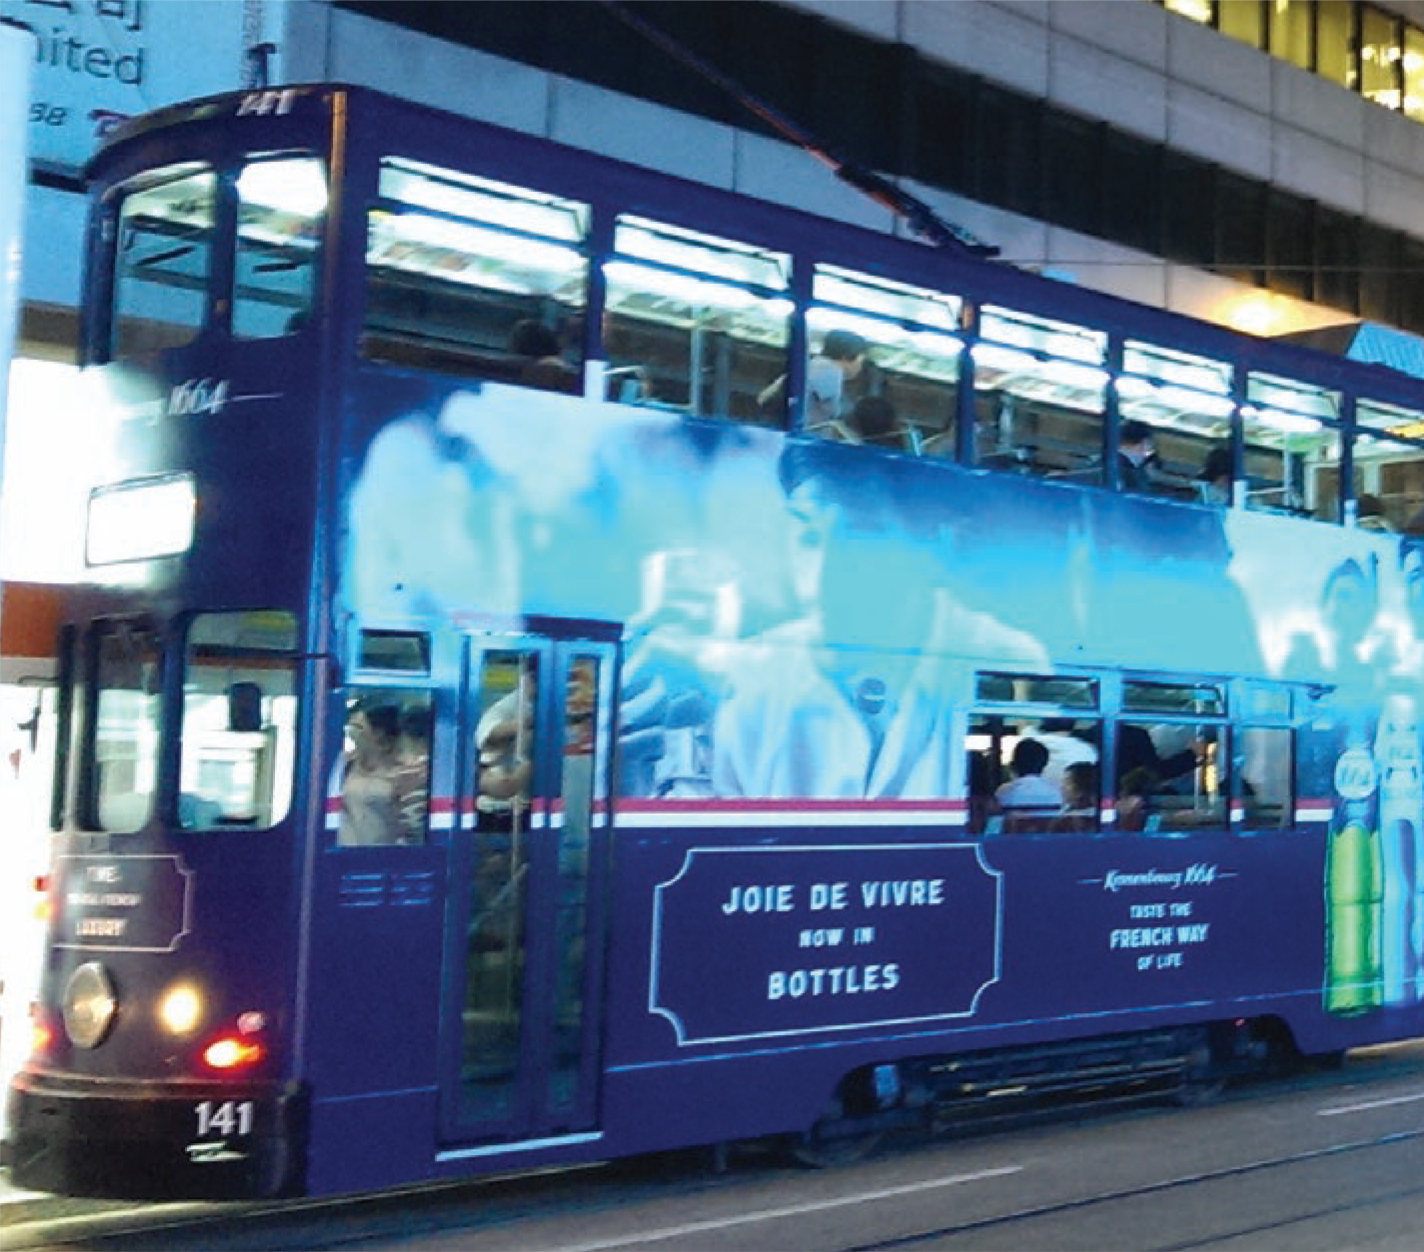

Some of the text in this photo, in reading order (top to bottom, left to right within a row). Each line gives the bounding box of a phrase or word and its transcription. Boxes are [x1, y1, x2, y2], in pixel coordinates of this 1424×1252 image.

[36, 26, 144, 85] ited
[722, 879, 946, 916] JOIE DE VIVRE
[799, 926, 876, 948] NOW IN
[1110, 923, 1210, 950] FRENCH WAY
[767, 963, 901, 1001] BOTTLES
[194, 1101, 254, 1136] 141
